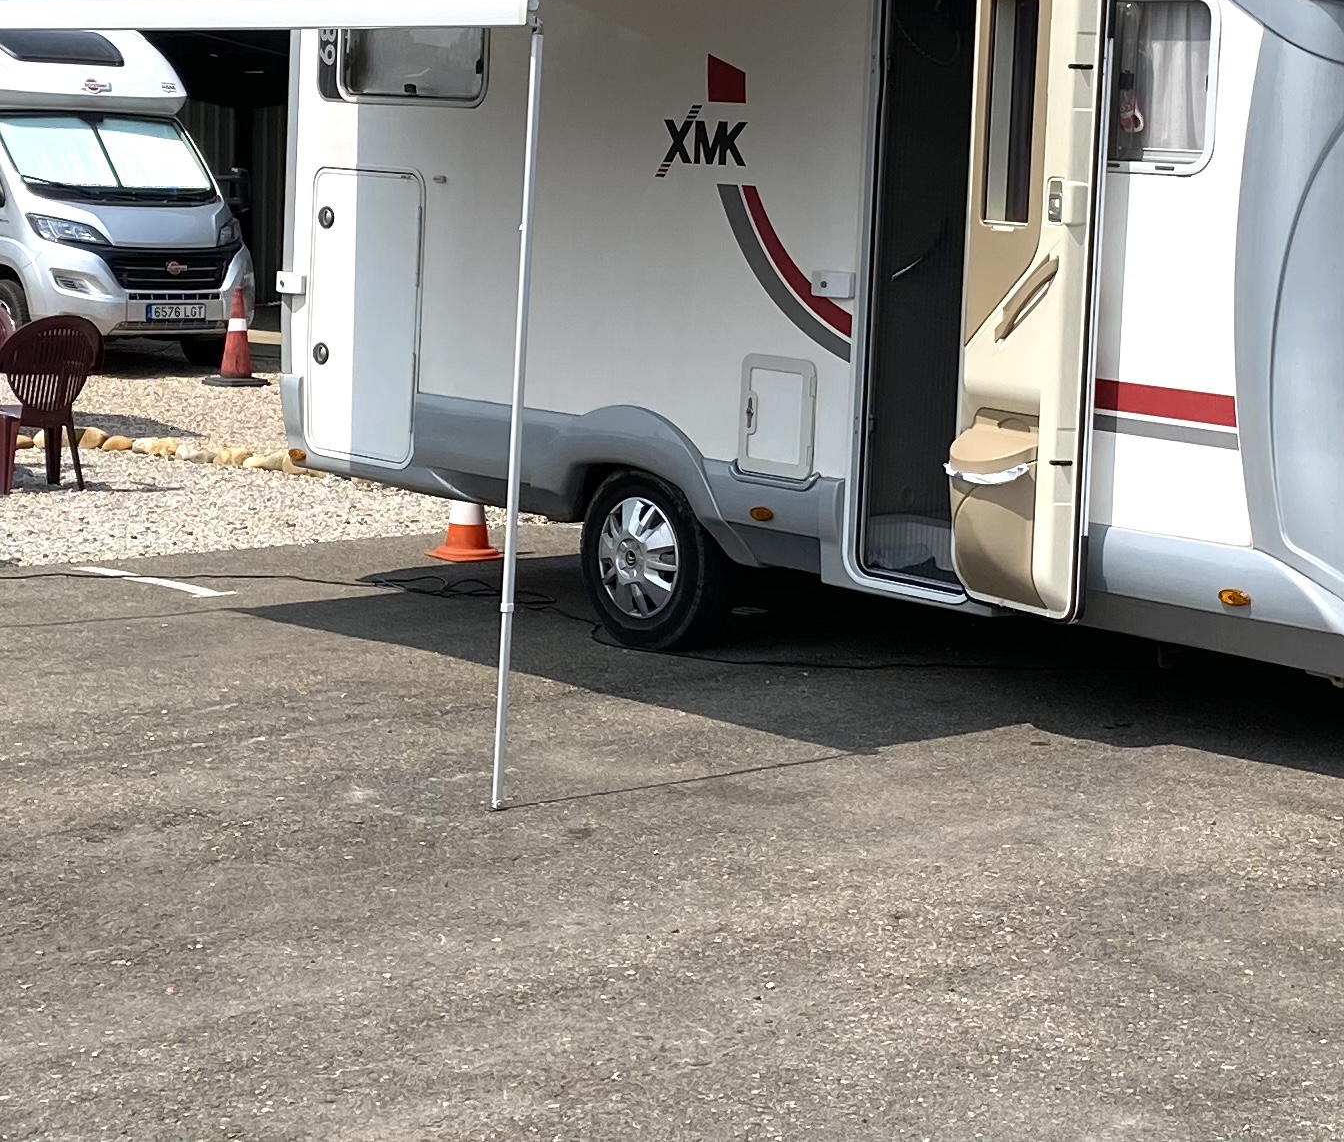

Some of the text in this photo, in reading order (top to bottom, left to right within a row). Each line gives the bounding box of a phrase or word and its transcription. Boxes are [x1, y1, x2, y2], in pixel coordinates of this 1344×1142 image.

[655, 104, 748, 178] XMK
[154, 306, 204, 318] 6576 LGT
